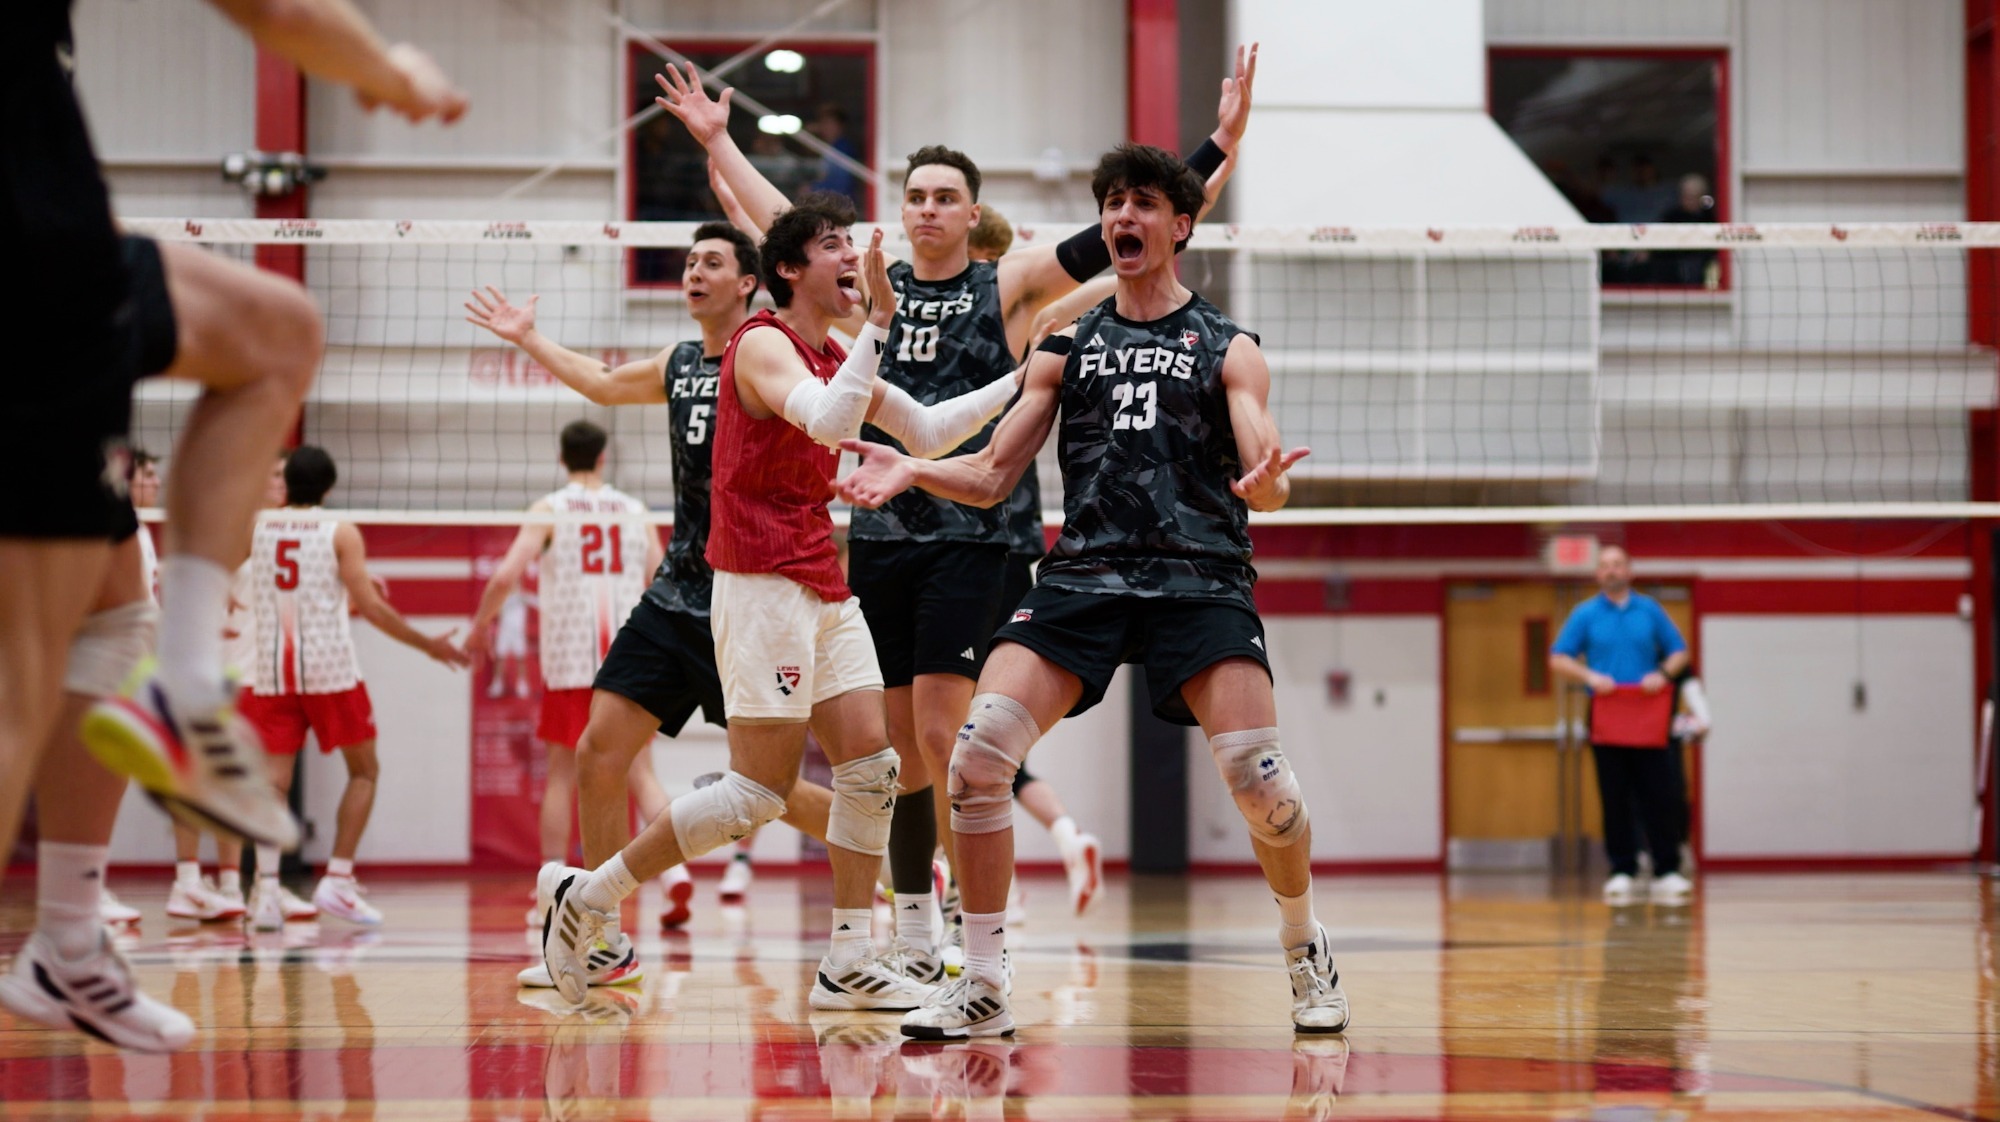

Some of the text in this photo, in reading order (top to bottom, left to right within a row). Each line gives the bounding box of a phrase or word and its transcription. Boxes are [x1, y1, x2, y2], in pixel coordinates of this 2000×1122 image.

[896, 322, 940, 362] 10
[1079, 346, 1197, 379] FLYERS
[686, 404, 711, 445] 5
[1112, 380, 1158, 431] 23
[275, 540, 300, 590] 5
[581, 524, 622, 574] 21
